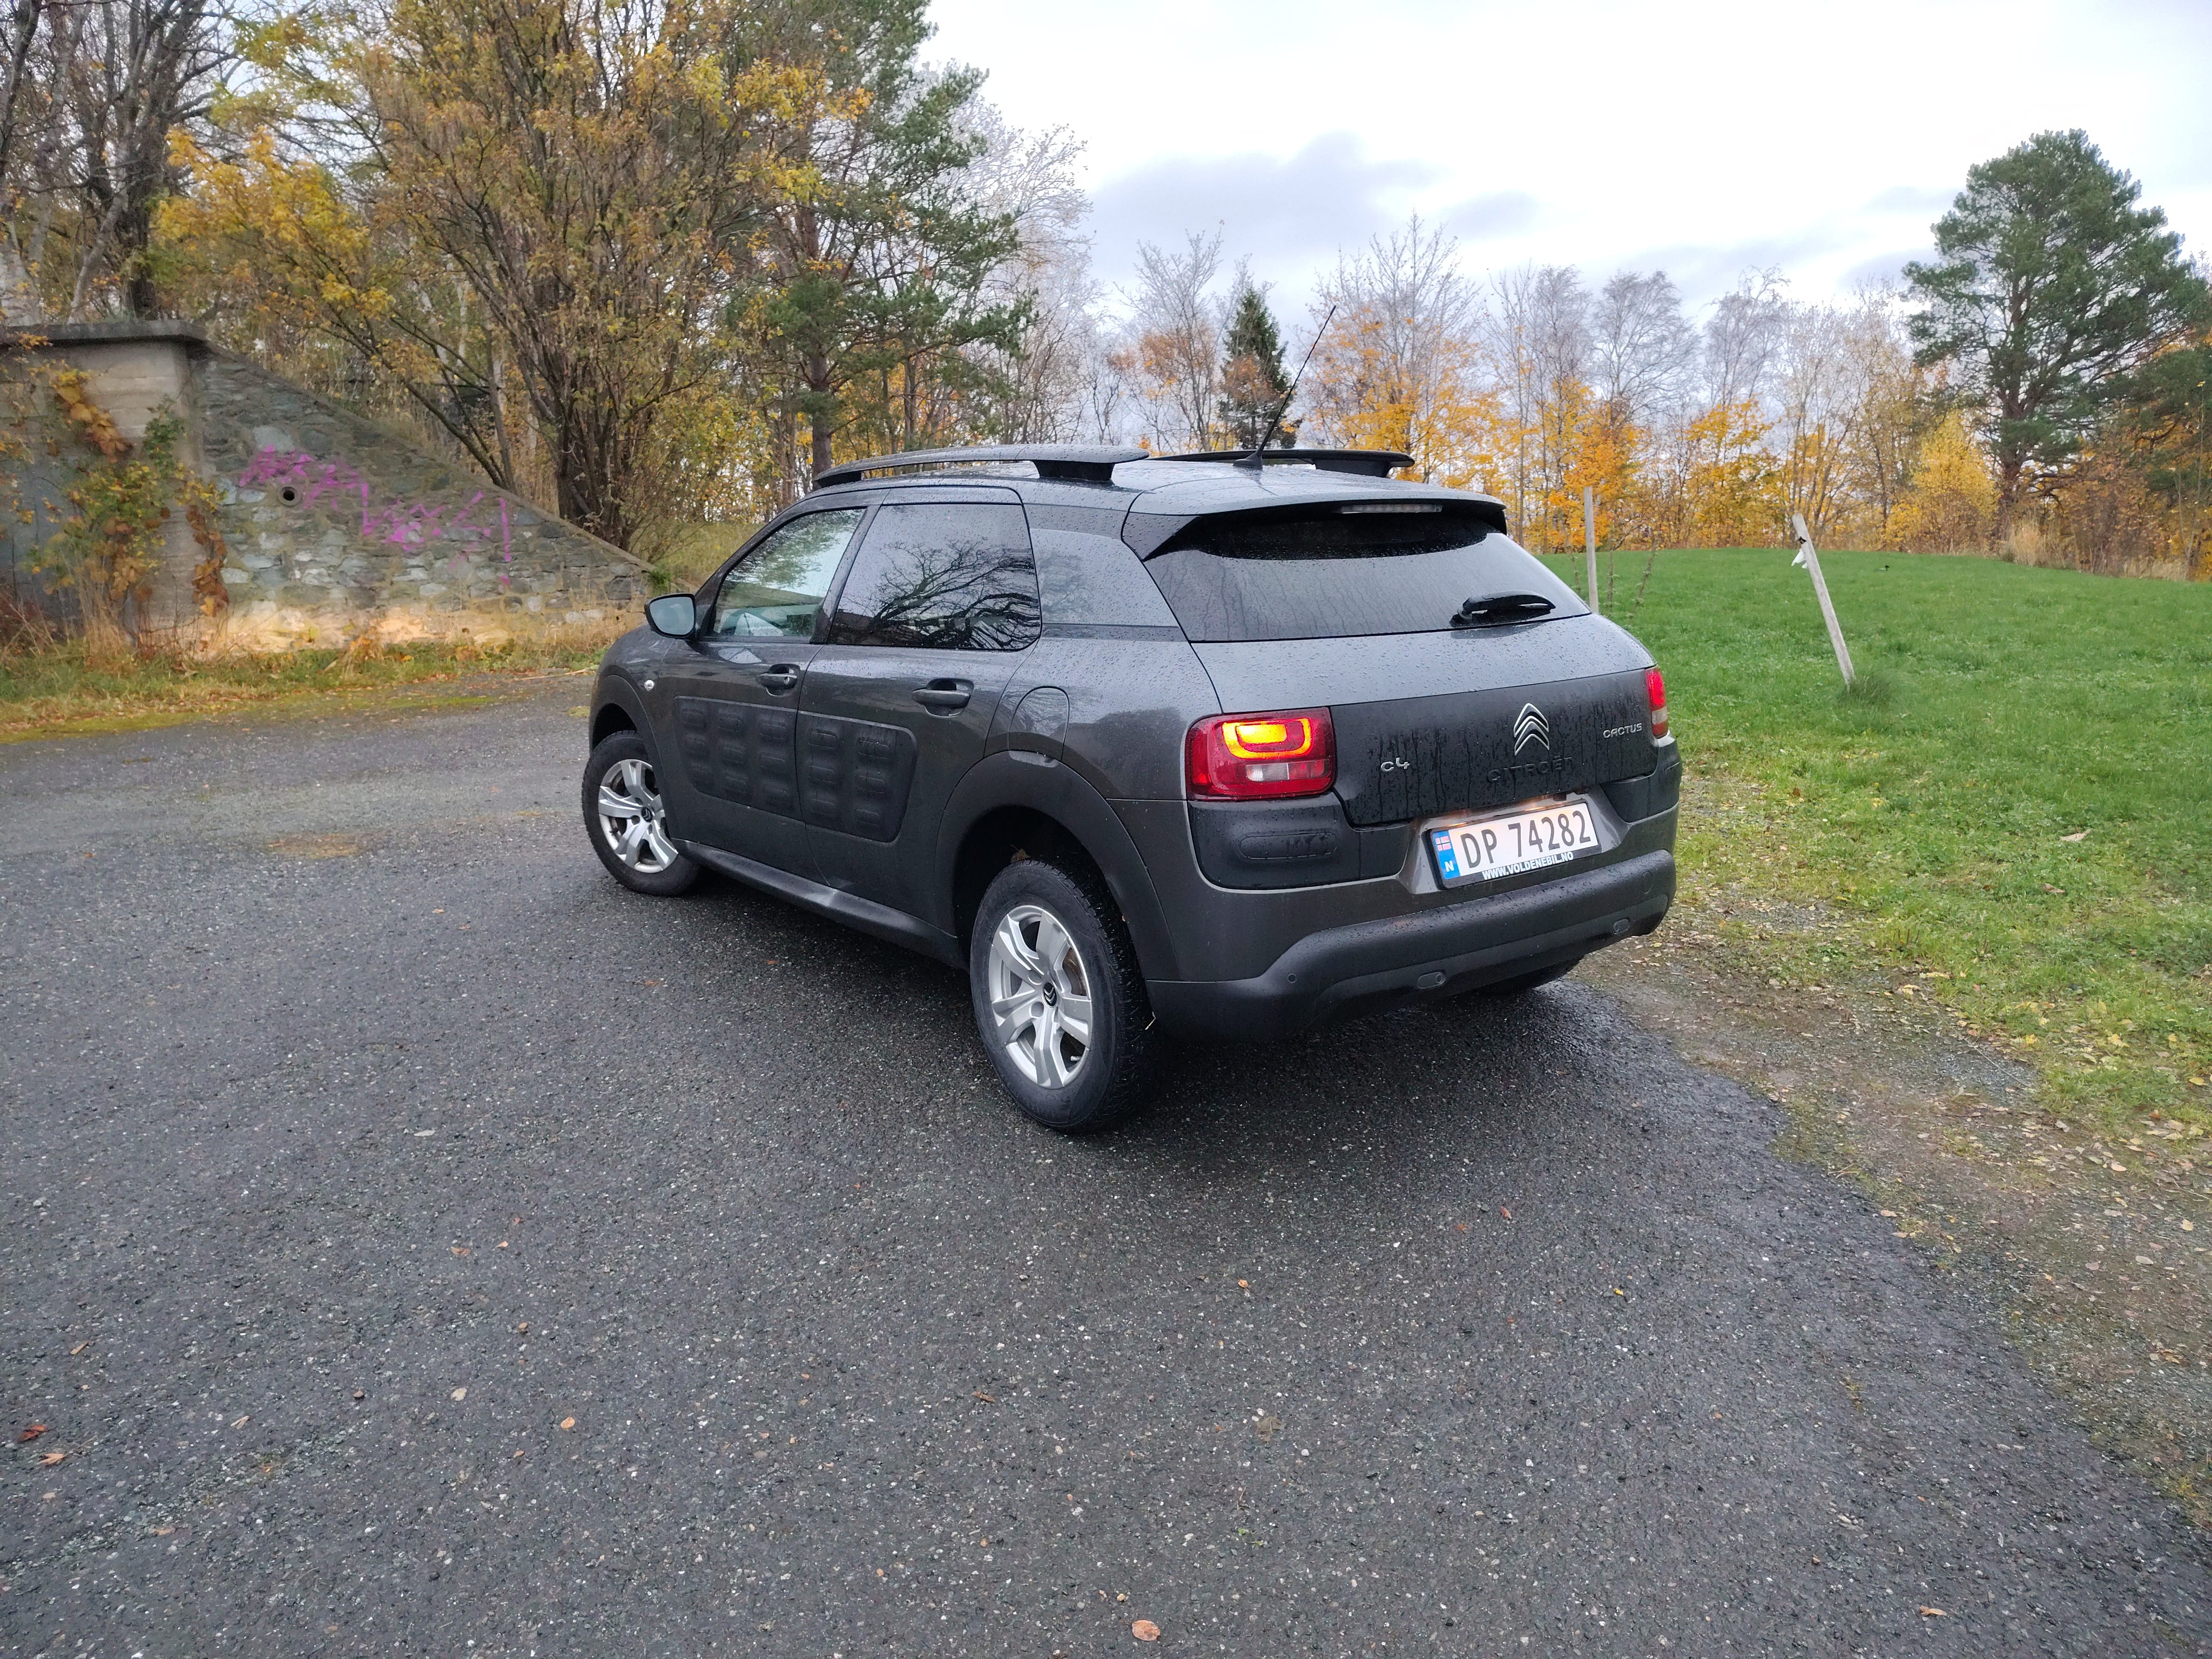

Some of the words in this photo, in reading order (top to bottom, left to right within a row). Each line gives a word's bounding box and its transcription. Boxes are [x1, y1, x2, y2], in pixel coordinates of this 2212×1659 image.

[1603, 723, 1642, 738] CACTUS
[1380, 757, 1410, 772] C4
[1460, 828, 1498, 868] DP
[1507, 810, 1591, 858] 74282
[1444, 860, 1455, 872] N
[1481, 851, 1574, 880] WWW.VOLDENEBIL.NO
